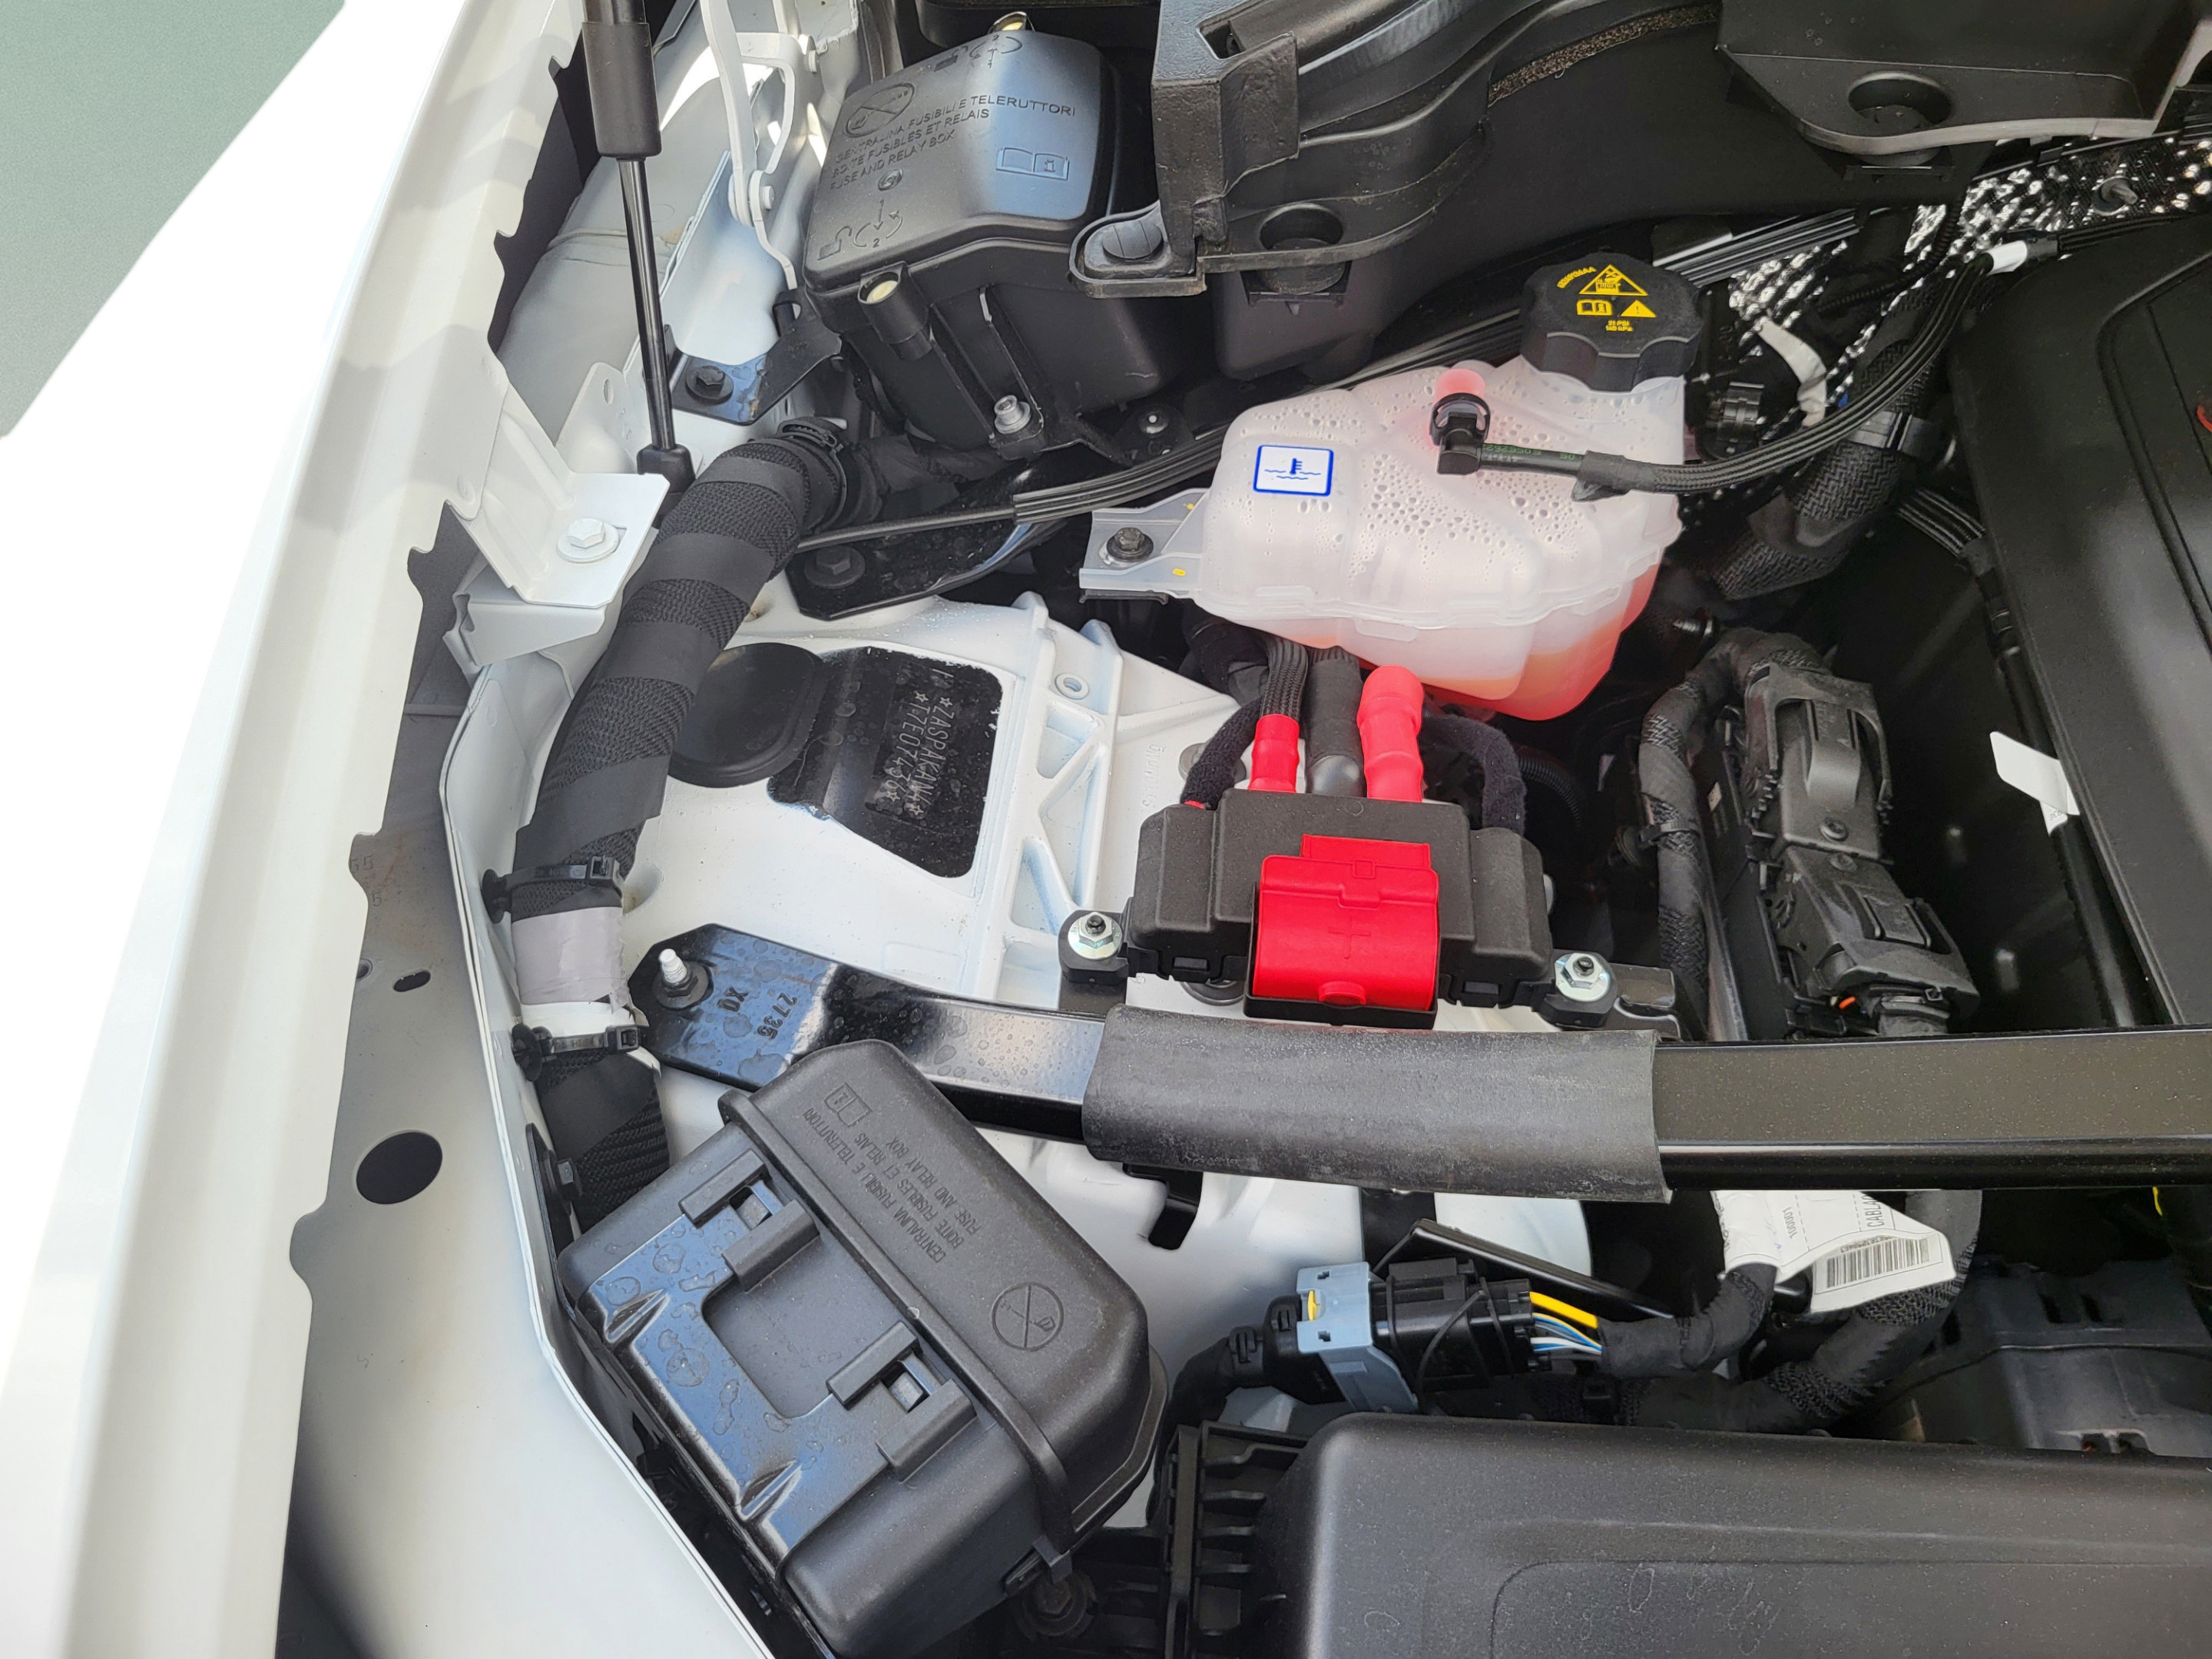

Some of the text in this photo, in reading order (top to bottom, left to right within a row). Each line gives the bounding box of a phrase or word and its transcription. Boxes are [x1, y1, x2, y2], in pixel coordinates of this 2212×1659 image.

[830, 129, 955, 190] FUSE AND RELAY BOX
[836, 94, 1075, 164] CENTRALINA FUSIBILI E TELERUTTORI
[868, 129, 922, 160] FUSIBLES
[926, 118, 942, 135] ET
[945, 108, 989, 127] RELAIS
[803, 1108, 945, 1263] CENTRALINA FUSIBILI E TELERUTTORI
[855, 1133, 963, 1249] BOITE FUSIBLES ET RELAIS
[888, 1137, 981, 1235] FUSE AND RELAY BOX
